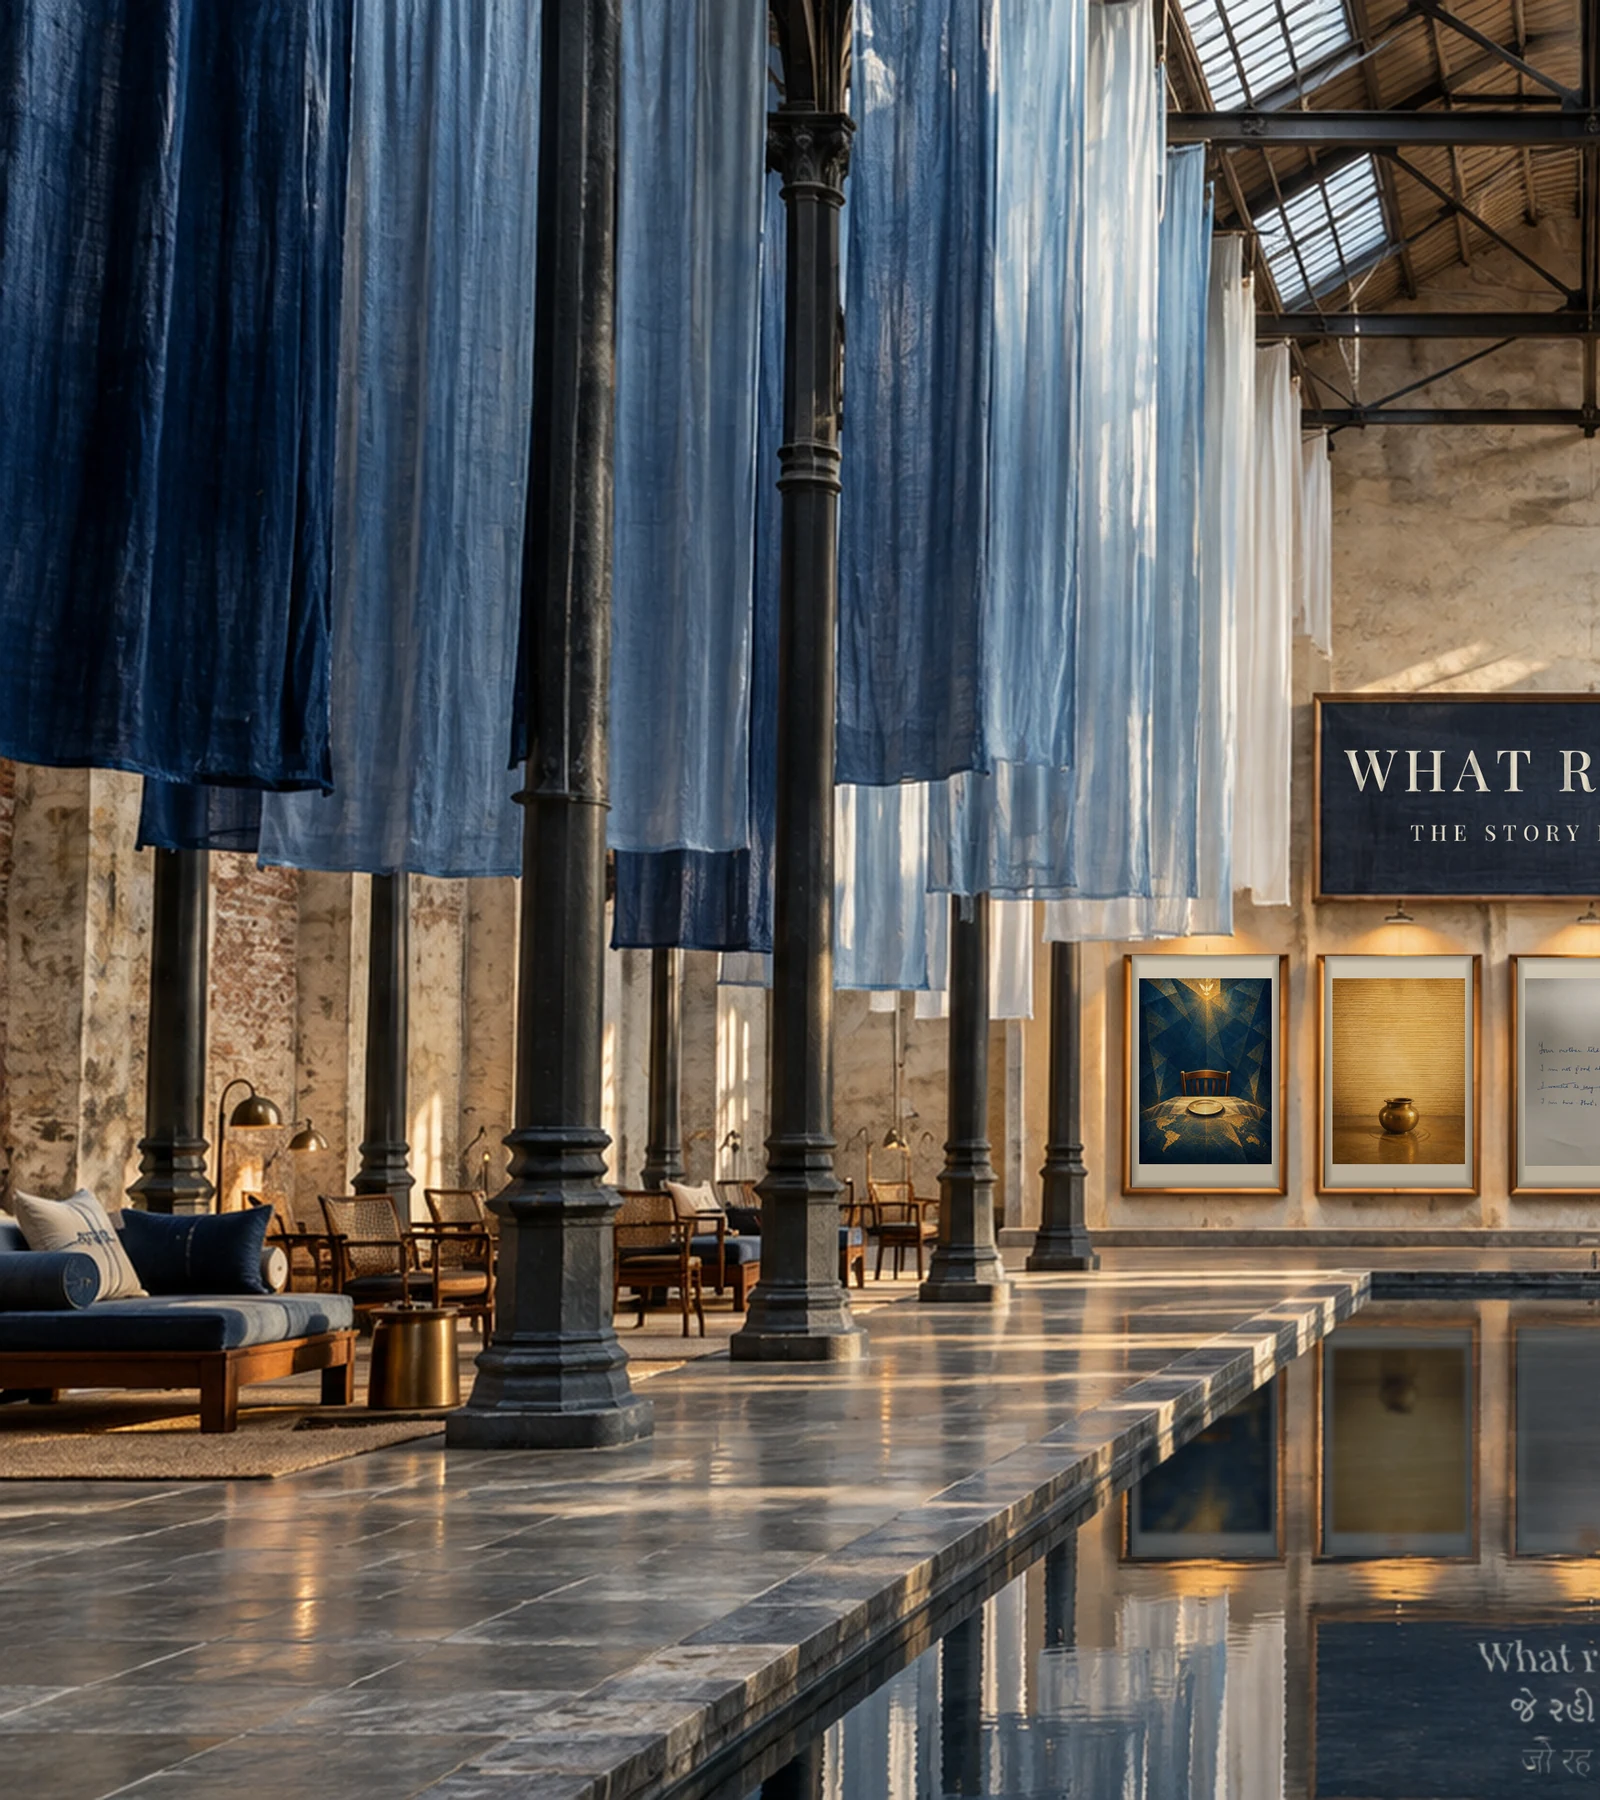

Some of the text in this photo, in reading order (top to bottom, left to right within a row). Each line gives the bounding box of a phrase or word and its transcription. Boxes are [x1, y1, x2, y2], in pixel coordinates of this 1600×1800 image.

[1344, 749, 1531, 793] WHAT
[1410, 823, 1467, 842] THE
[1485, 823, 1580, 842] STORY
[1575, 1065, 1591, 1075] good
[1477, 1639, 1575, 1674] What
[1510, 1687, 1538, 1723] જે
[1548, 1687, 1596, 1723] રહી
[1521, 1739, 1556, 1775] जो
[1562, 1748, 1594, 1777] रह
